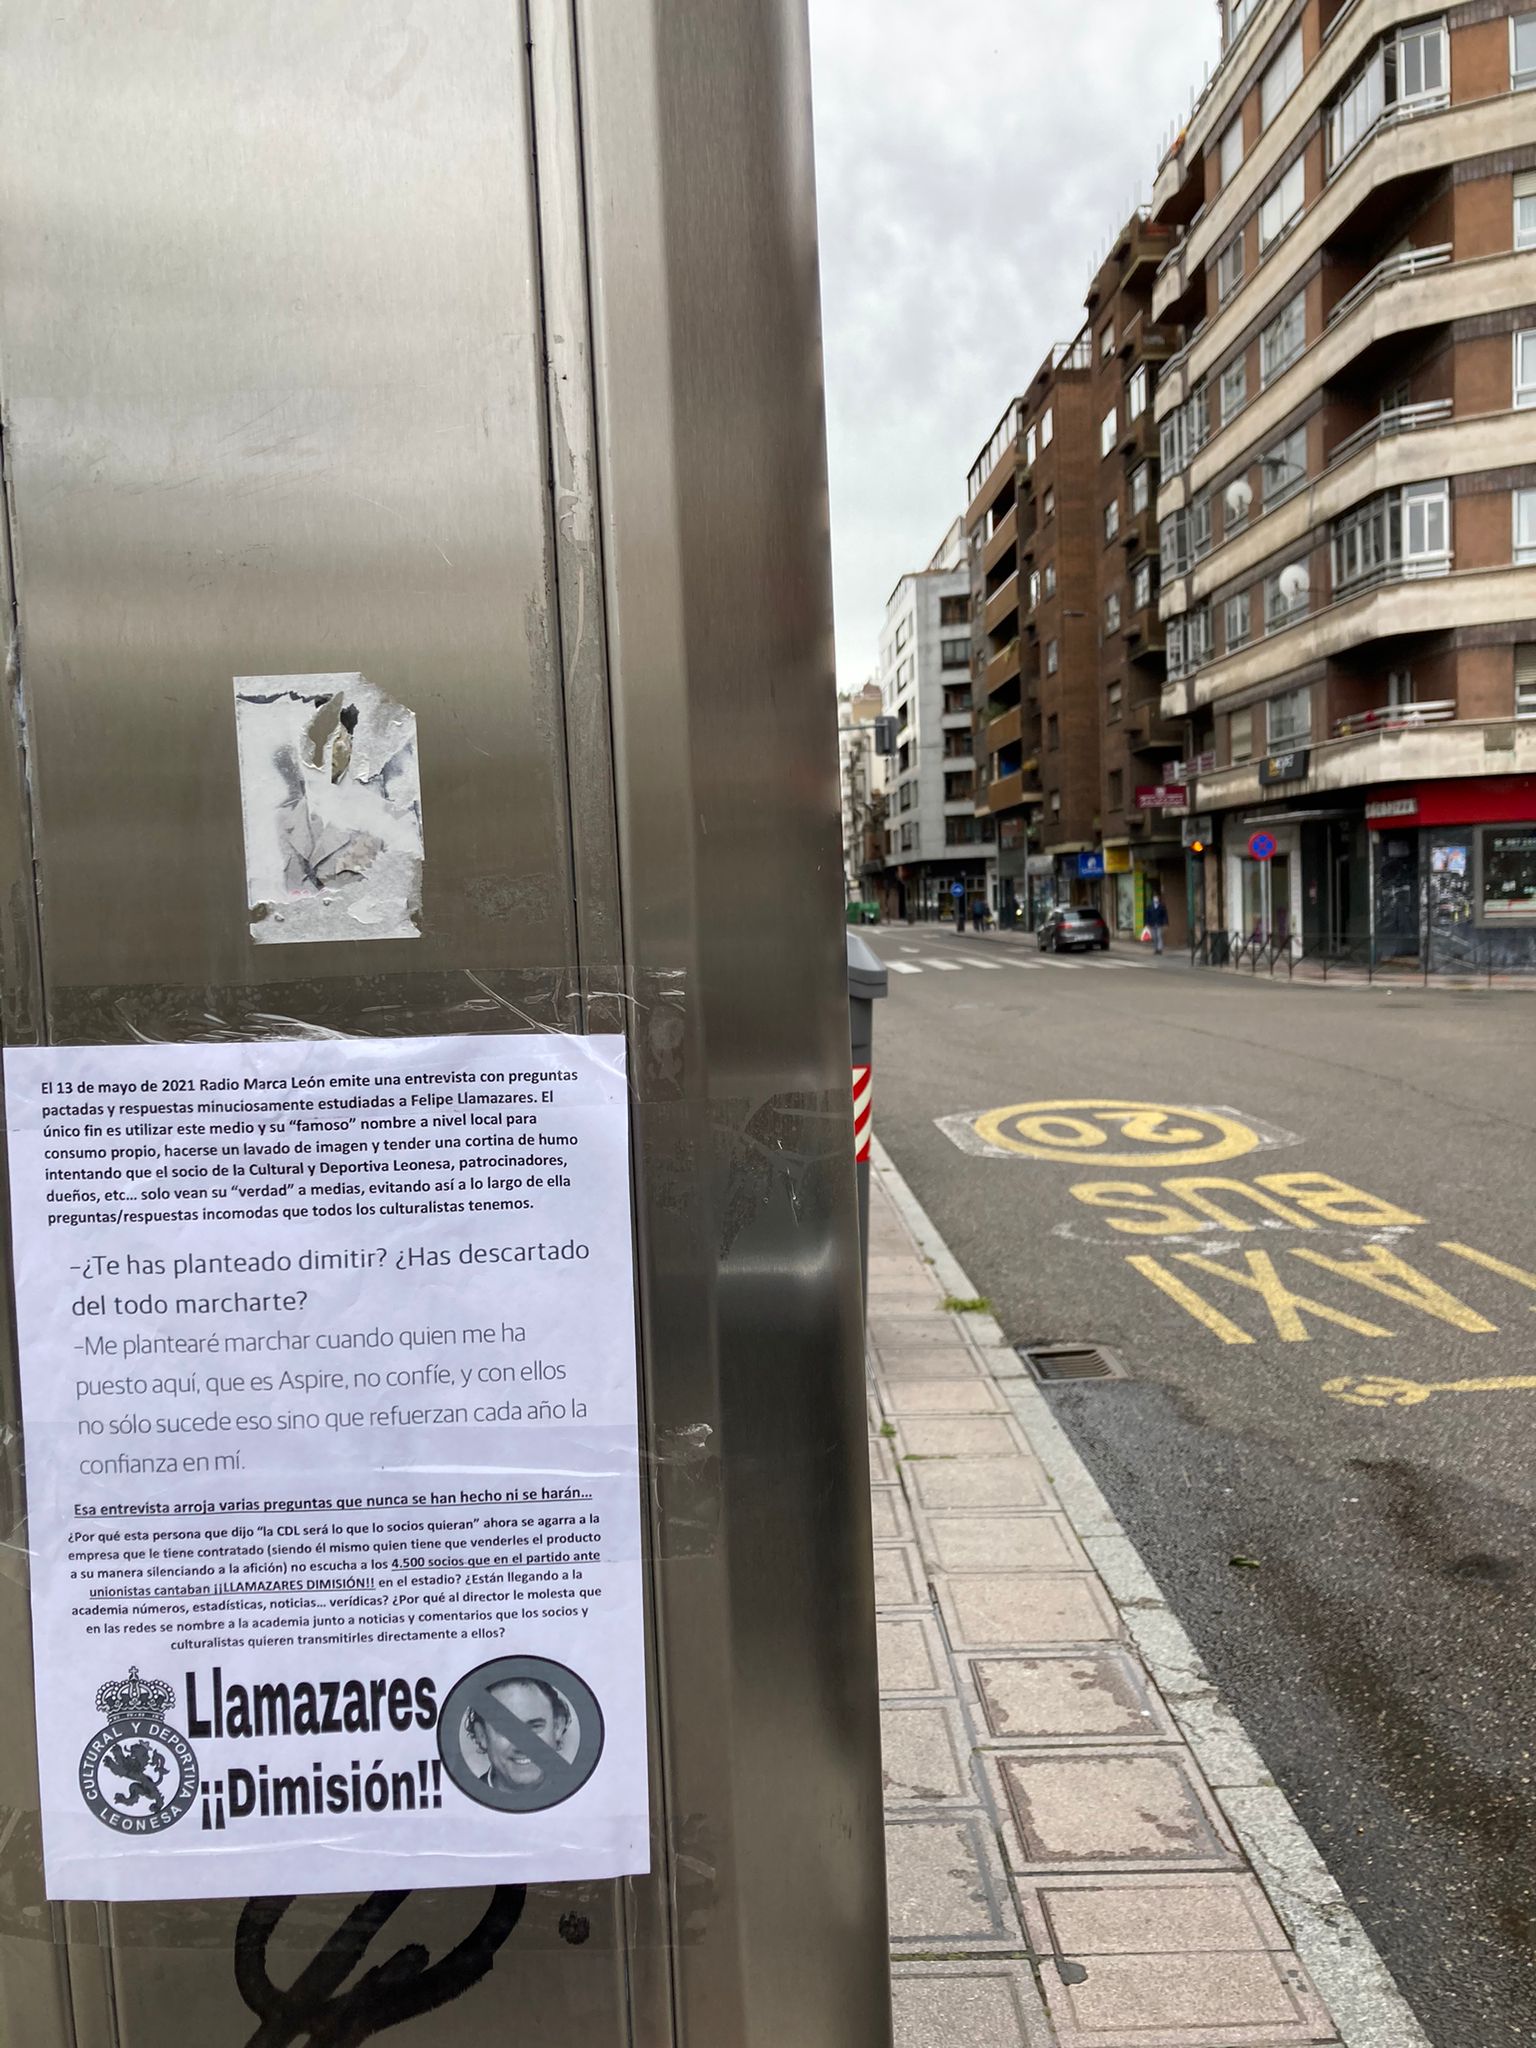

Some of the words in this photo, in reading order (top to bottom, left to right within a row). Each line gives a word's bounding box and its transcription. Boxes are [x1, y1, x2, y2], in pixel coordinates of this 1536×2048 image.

[41, 1081, 52, 1094] El
[56, 1081, 73, 1094] 13
[77, 1080, 94, 1093] de
[98, 1083, 137, 1095] mayo
[140, 1079, 158, 1092] de
[161, 1079, 195, 1091] 2021
[199, 1077, 239, 1091] Radio
[243, 1078, 287, 1090] Marca
[291, 1075, 325, 1088] León
[329, 1074, 370, 1087] emite
[374, 1075, 400, 1086] una
[404, 1070, 476, 1085] entrevista
[480, 1072, 504, 1082] con
[508, 1070, 578, 1085] preguntas
[42, 1102, 104, 1119] pactadas
[107, 1105, 115, 1118] y
[119, 1102, 193, 1117] respuestas
[197, 1099, 314, 1113] minuciosamente
[317, 1095, 395, 1110] estudiadas
[398, 1097, 407, 1107] a
[411, 1091, 453, 1109] Felipe
[457, 1091, 537, 1104] Llamazares.
[541, 1090, 553, 1103] El
[1017, 1112, 1206, 1147] 20
[44, 1149, 107, 1159] consumo
[110, 1144, 160, 1161] propio,
[164, 1144, 218, 1157] hacerse
[221, 1146, 239, 1155] un
[243, 1141, 290, 1155] lavado
[294, 1140, 311, 1153] de
[315, 1140, 367, 1155] imagen
[371, 1141, 380, 1154] y
[383, 1136, 431, 1150] tender
[434, 1138, 461, 1148] una
[465, 1133, 514, 1147] cortina
[517, 1133, 535, 1145] de
[538, 1132, 578, 1145] humo
[45, 1166, 122, 1180] intentando
[125, 1168, 152, 1181] que
[155, 1165, 168, 1178] el
[171, 1164, 208, 1178] socio
[211, 1163, 229, 1176] de
[232, 1163, 245, 1176] la
[249, 1162, 304, 1175] Cultural
[307, 1164, 316, 1176] y
[319, 1159, 389, 1176] Deportiva
[393, 1159, 455, 1171] Leonesa,
[459, 1153, 567, 1171] patrocinadores,
[47, 1209, 198, 1226] preguntas/respuestas
[202, 1205, 278, 1220] incomodas
[282, 1207, 308, 1220] que
[311, 1203, 352, 1216] todos
[356, 1202, 375, 1215] los
[379, 1200, 465, 1215] culturalistas
[468, 1199, 533, 1211] tenemos.
[1069, 1172, 1428, 1236] BUS
[126, 1254, 165, 1275] has
[174, 1250, 291, 1279] planteado
[298, 1247, 387, 1270] dimitir?
[395, 1246, 451, 1270] ¿Has
[458, 1239, 589, 1264] descartado
[71, 1294, 105, 1316] del
[113, 1293, 168, 1315] todo
[175, 1290, 307, 1313] marcharte?
[123, 1332, 219, 1360] plantearé
[224, 1330, 310, 1352] marchar
[315, 1326, 394, 1349] cuando
[399, 1326, 456, 1350] quien
[462, 1328, 496, 1343] me
[501, 1322, 525, 1342] ha
[76, 1376, 147, 1400] puesto
[151, 1371, 200, 1397] aquí,
[205, 1376, 245, 1396] que
[250, 1375, 273, 1391] es
[278, 1369, 348, 1394] Aspire,
[354, 1372, 380, 1387] no
[386, 1363, 455, 1386] confíe,
[460, 1368, 472, 1388] y
[477, 1366, 515, 1382] con
[520, 1359, 566, 1381] ellos
[78, 1420, 104, 1435] no
[109, 1413, 151, 1434] sólo
[156, 1410, 231, 1433] sucede
[235, 1415, 272, 1430] eso
[277, 1410, 319, 1430] sino
[325, 1411, 364, 1430] que
[370, 1405, 467, 1426] refuerzan
[473, 1400, 521, 1422] cada
[527, 1400, 566, 1419] año
[571, 1397, 587, 1418] la
[79, 1452, 177, 1474] confianza
[182, 1456, 209, 1472] en
[214, 1449, 245, 1470] mí.
[74, 1503, 96, 1515] Esa
[100, 1501, 170, 1515] entrevista
[173, 1499, 215, 1513] arroja
[218, 1497, 260, 1511] varias
[263, 1498, 332, 1512] preguntas
[336, 1498, 362, 1510] que
[366, 1495, 408, 1506] nunca
[412, 1495, 426, 1504] se
[430, 1491, 456, 1504] han
[460, 1489, 502, 1502] hecho
[505, 1488, 518, 1501] ni
[522, 1490, 537, 1500] se
[67, 1551, 119, 1562] empresa
[122, 1550, 145, 1561] que
[149, 1548, 159, 1559] le
[162, 1547, 194, 1558] tiene
[197, 1544, 264, 1557] contratado
[267, 1543, 312, 1557] (siendo
[315, 1542, 326, 1553] él
[329, 1541, 370, 1552] mismo
[372, 1539, 407, 1553] quien
[410, 1538, 441, 1549] tiene
[444, 1540, 467, 1550] que
[470, 1534, 529, 1547] venderles
[532, 1533, 542, 1544] el
[546, 1532, 601, 1546] producto
[89, 1585, 151, 1597] unionistas
[154, 1583, 210, 1595] cantaban
[306, 1575, 374, 1590] DIMISIÓN!!
[378, 1579, 393, 1587] en
[396, 1575, 407, 1587] el
[411, 1573, 461, 1586] estadio?
[465, 1572, 503, 1585] ¿Están
[507, 1570, 559, 1584] llegando
[562, 1572, 568, 1580] a
[572, 1569, 582, 1579] la
[170, 1637, 244, 1650] culturalistas
[247, 1635, 294, 1649] quieren
[297, 1632, 373, 1645] transmitirles
[376, 1629, 457, 1642] directamente
[461, 1630, 467, 1638] a
[471, 1626, 505, 1638] ellos?
[186, 1667, 438, 1739] Llamazares
[81, 1726, 123, 1801] CULTURAL
[131, 1721, 141, 1734] Y
[148, 1724, 197, 1799] DEPORTIVA
[200, 1759, 446, 1831] ¡¡Dimisión!!
[99, 1806, 183, 1832] LEONESA
